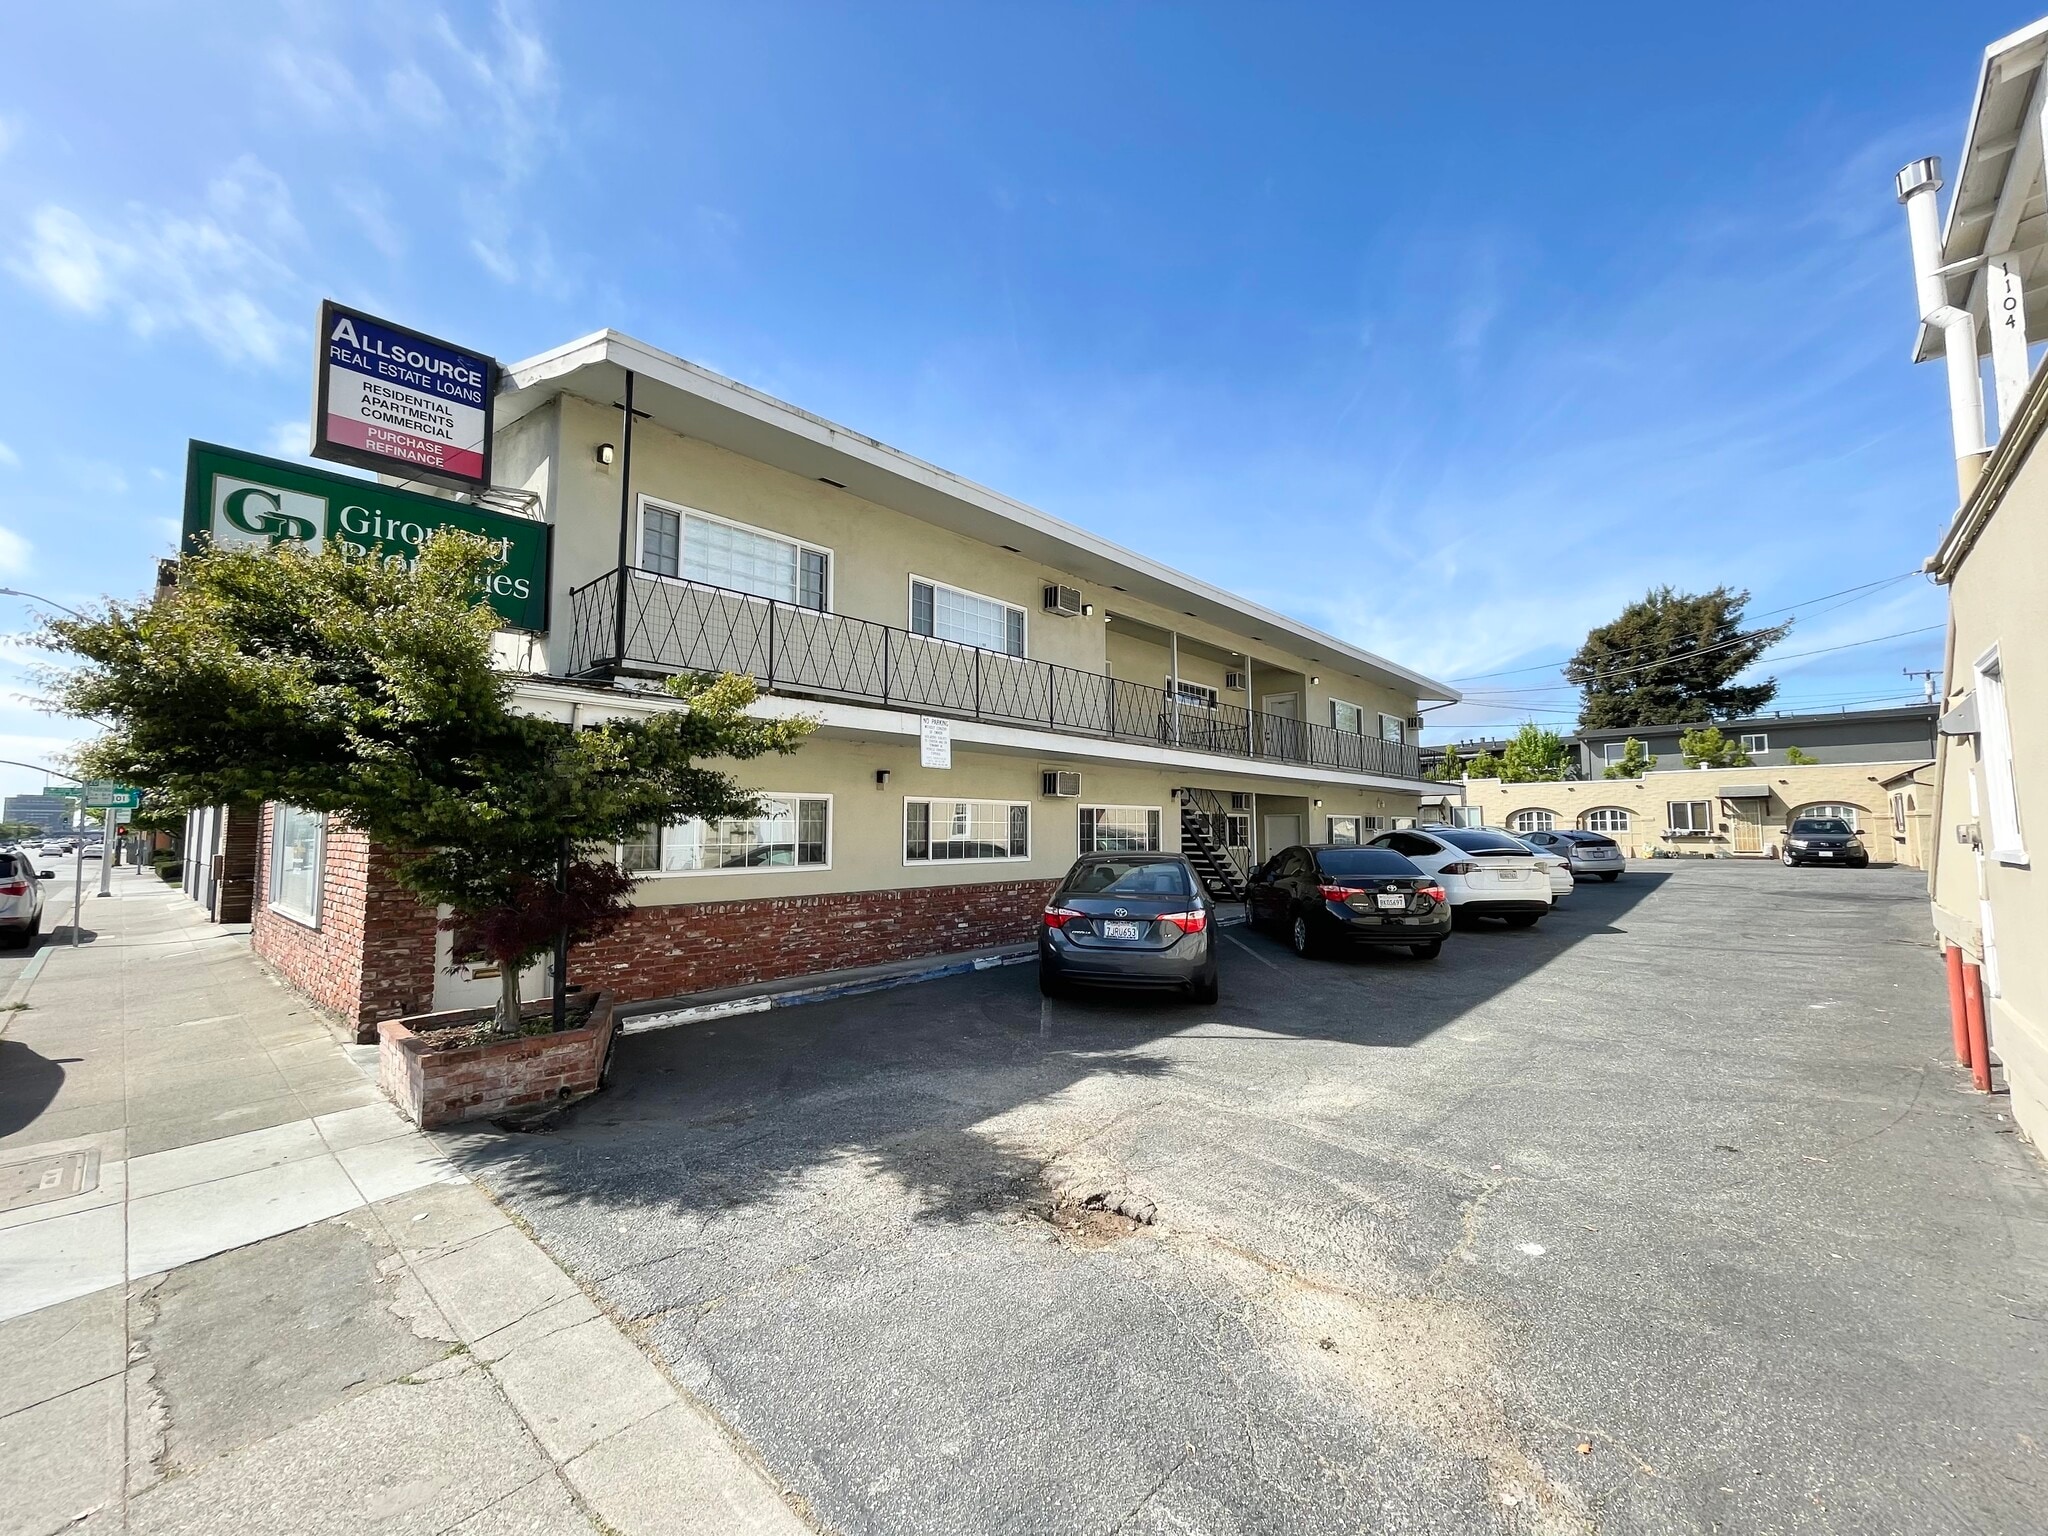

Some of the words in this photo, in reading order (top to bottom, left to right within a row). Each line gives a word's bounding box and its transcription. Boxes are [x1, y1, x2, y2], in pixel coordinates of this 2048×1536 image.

[2002, 262, 2017, 329] 1104
[331, 318, 482, 388] ALLSOURCE
[330, 345, 372, 370] REAL
[378, 361, 431, 389] ESTATE
[437, 380, 482, 404] LOANS
[361, 395, 454, 428] APARTMENTS
[363, 381, 453, 416] RESIDENTIAL
[361, 407, 453, 440] COMMERCIAL
[368, 427, 443, 455] PURCHASE
[366, 440, 444, 468] REFINANCE
[340, 505, 509, 564] Girod
